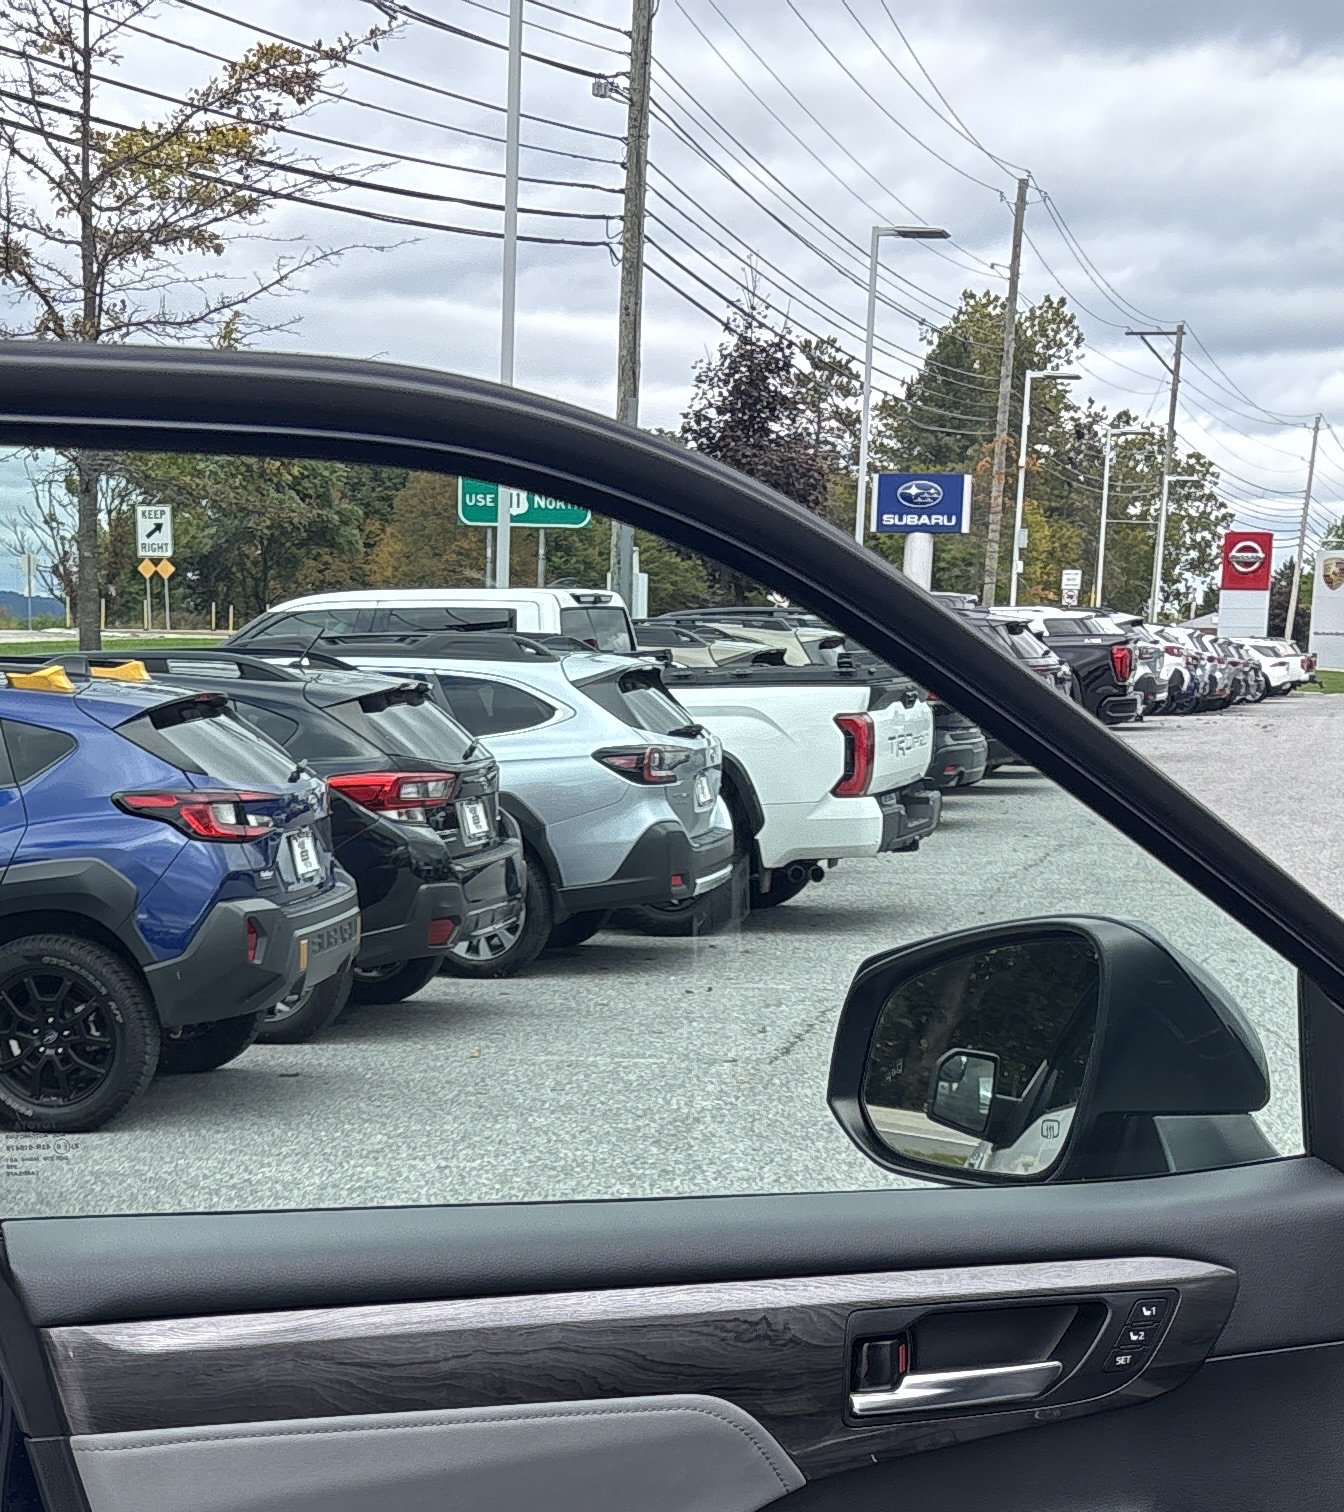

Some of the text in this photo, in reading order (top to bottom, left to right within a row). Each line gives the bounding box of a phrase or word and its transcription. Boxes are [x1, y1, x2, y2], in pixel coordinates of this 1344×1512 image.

[465, 494, 495, 507] USE
[141, 510, 166, 519] KEEP
[882, 514, 956, 526] SUBARU
[141, 543, 169, 553] RIGHT
[1115, 1355, 1132, 1366] SET
